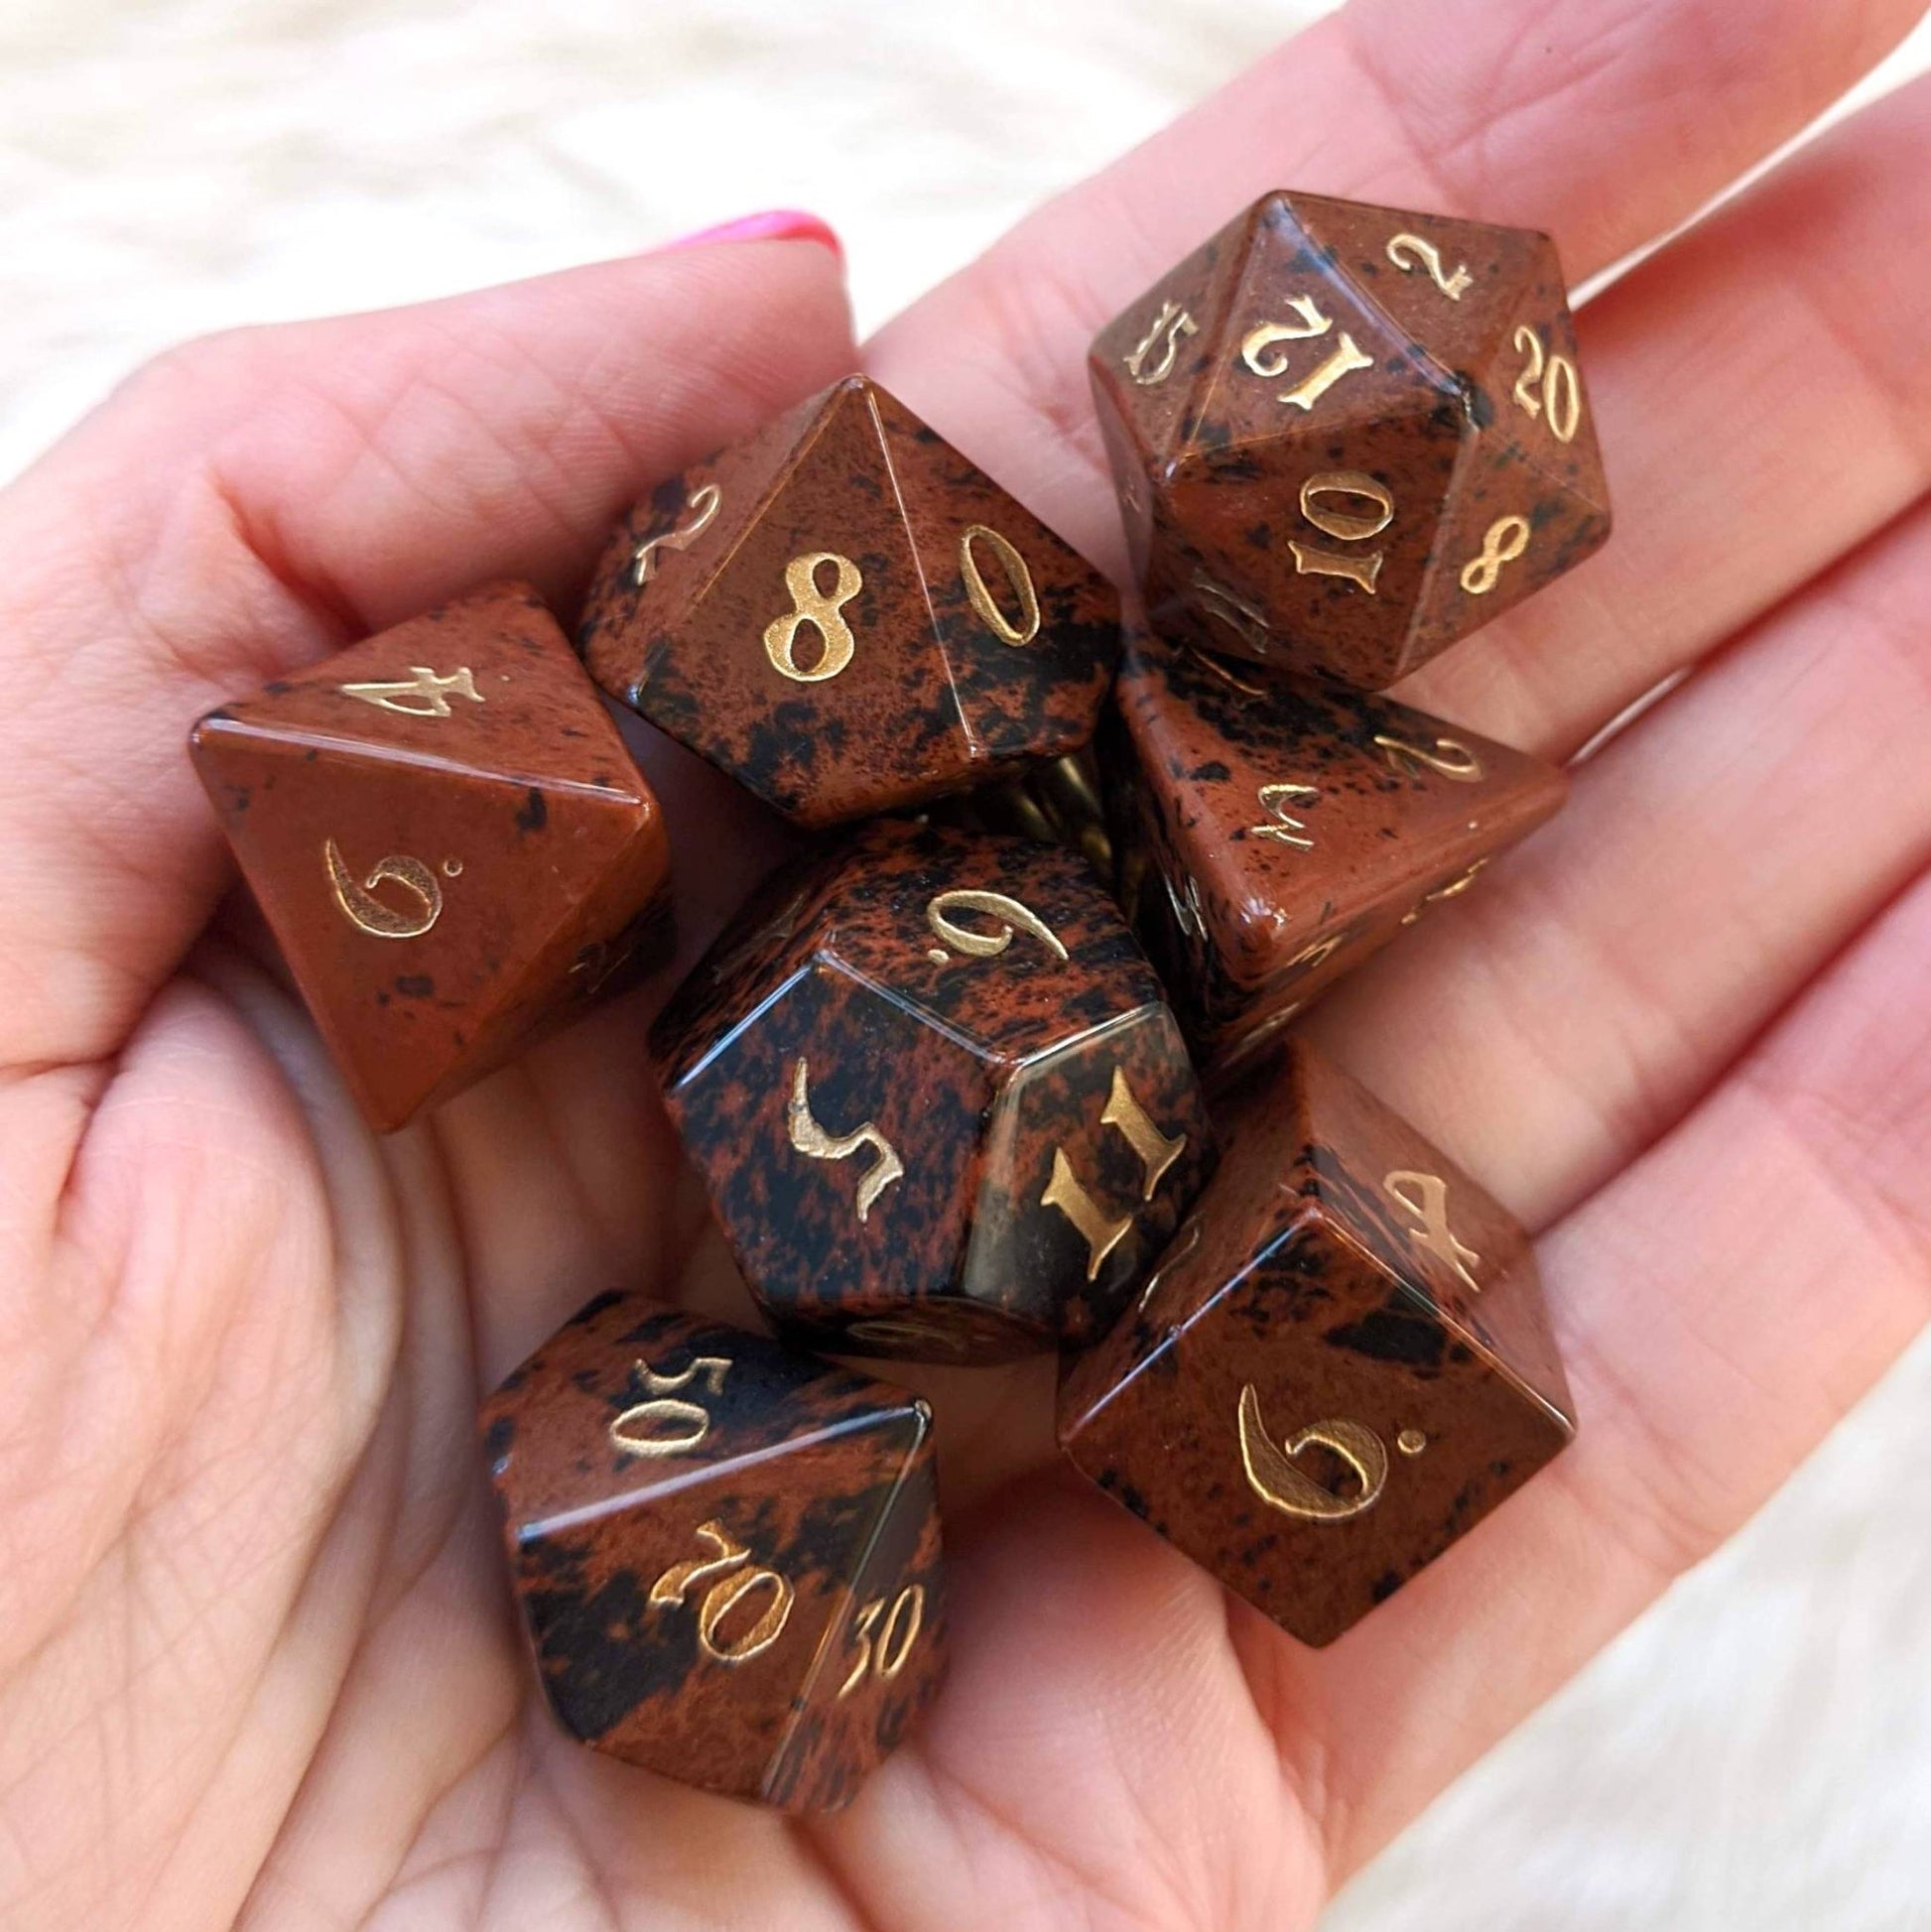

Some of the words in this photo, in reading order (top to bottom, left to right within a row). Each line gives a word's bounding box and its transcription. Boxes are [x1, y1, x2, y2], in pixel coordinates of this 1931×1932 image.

[1386, 233, 1474, 300] 2
[1240, 295, 1373, 410] 12
[1512, 324, 1580, 444] 20
[959, 525, 1041, 647] 0
[1288, 470, 1393, 594] 10
[1460, 515, 1530, 594] 8
[763, 552, 862, 682] 8
[341, 666, 485, 717] 4
[787, 1056, 905, 1224] 5
[1041, 1065, 1188, 1281] 11
[1384, 1170, 1480, 1292] 4
[609, 1357, 733, 1457] 50
[838, 1585, 924, 1700] 30
